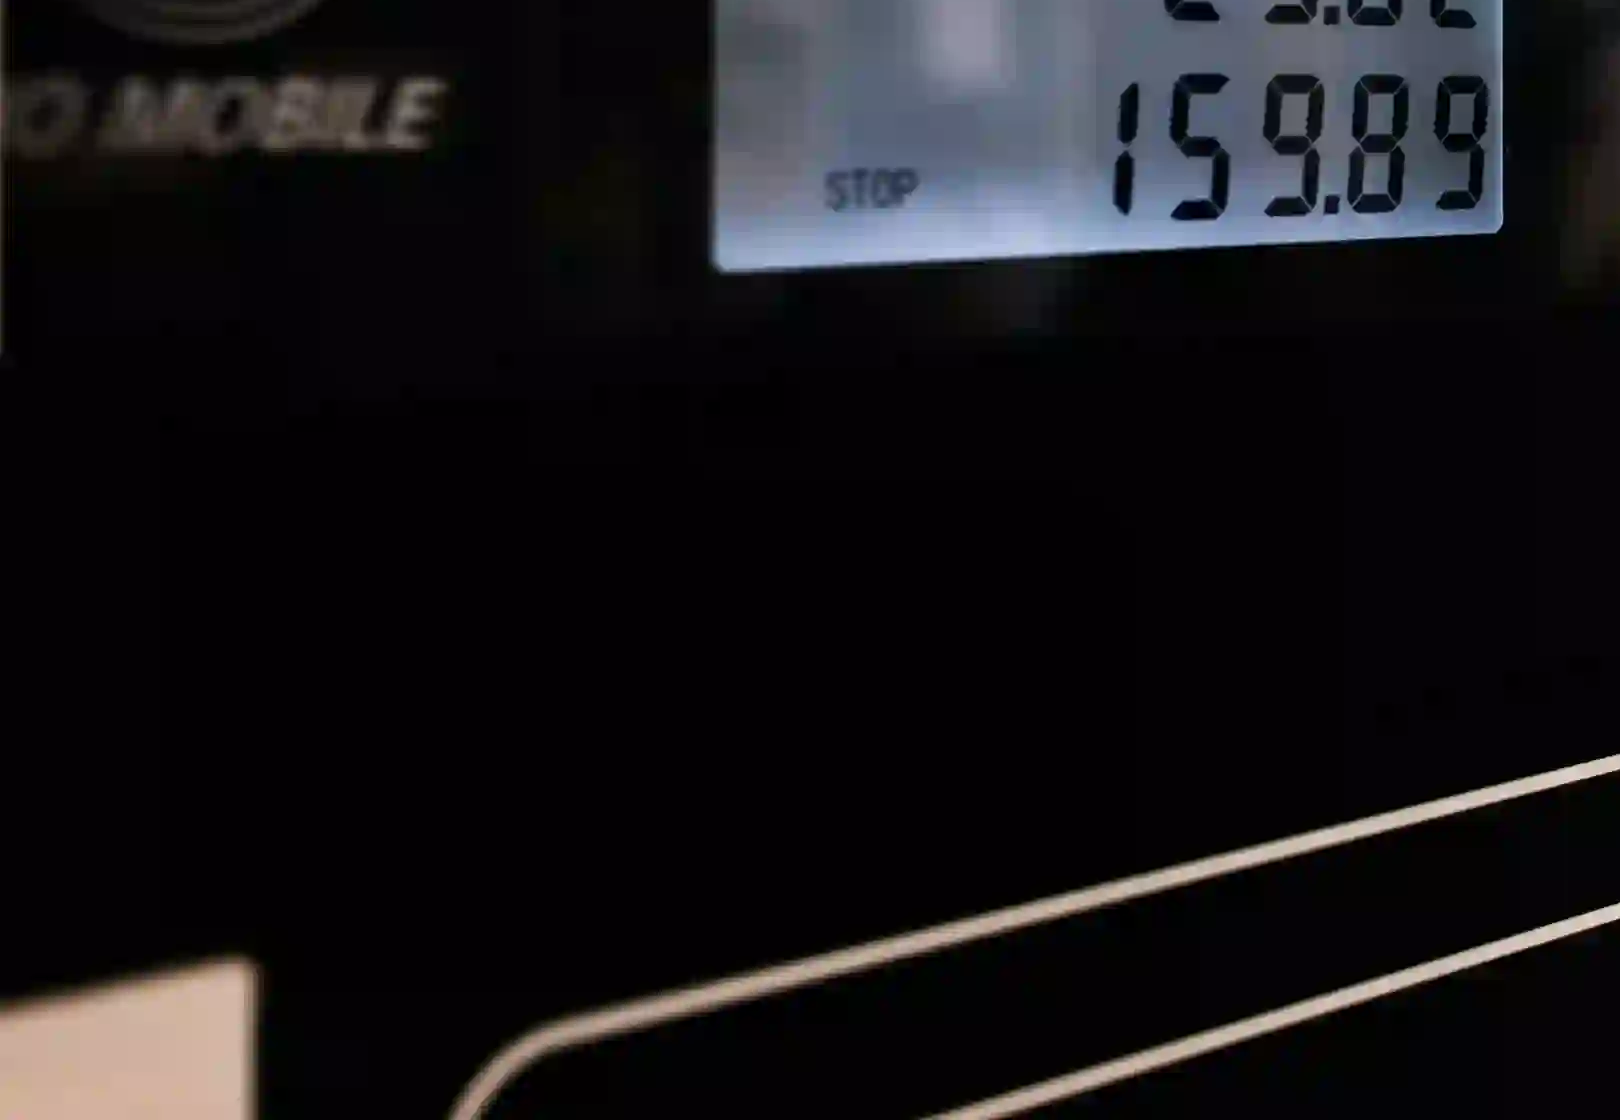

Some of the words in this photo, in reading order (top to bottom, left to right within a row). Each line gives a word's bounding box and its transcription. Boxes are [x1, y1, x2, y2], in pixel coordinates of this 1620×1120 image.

[103, 74, 447, 157] MOBILE
[1113, 71, 1488, 221] 159.89
[824, 167, 920, 212] STOP
